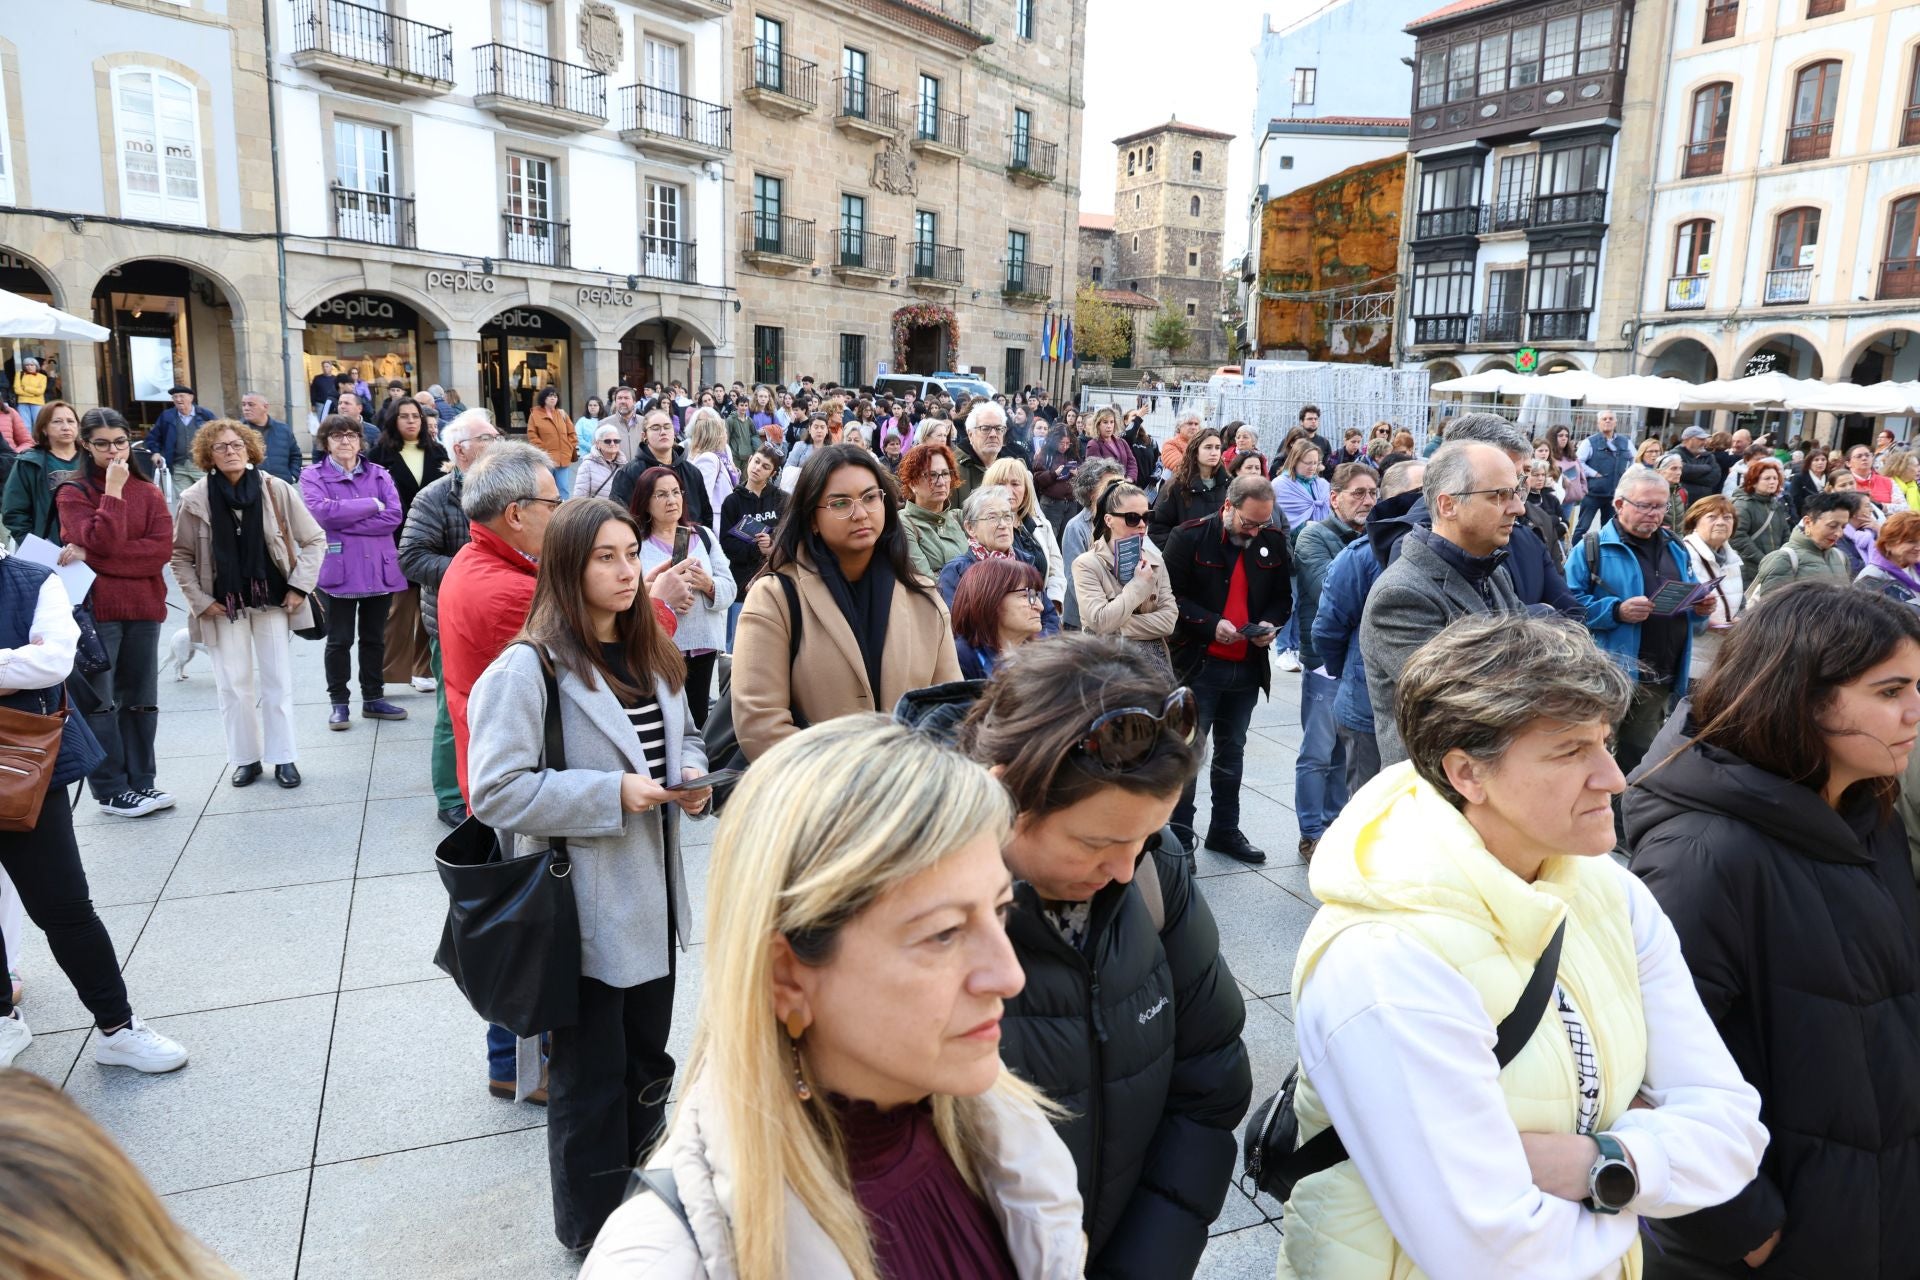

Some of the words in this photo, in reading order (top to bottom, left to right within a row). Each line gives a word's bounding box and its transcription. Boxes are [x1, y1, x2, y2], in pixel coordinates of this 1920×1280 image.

[427, 271, 496, 294] pepita
[316, 296, 394, 320] pepita
[577, 286, 633, 308] pepita
[488, 309, 542, 330] epita
